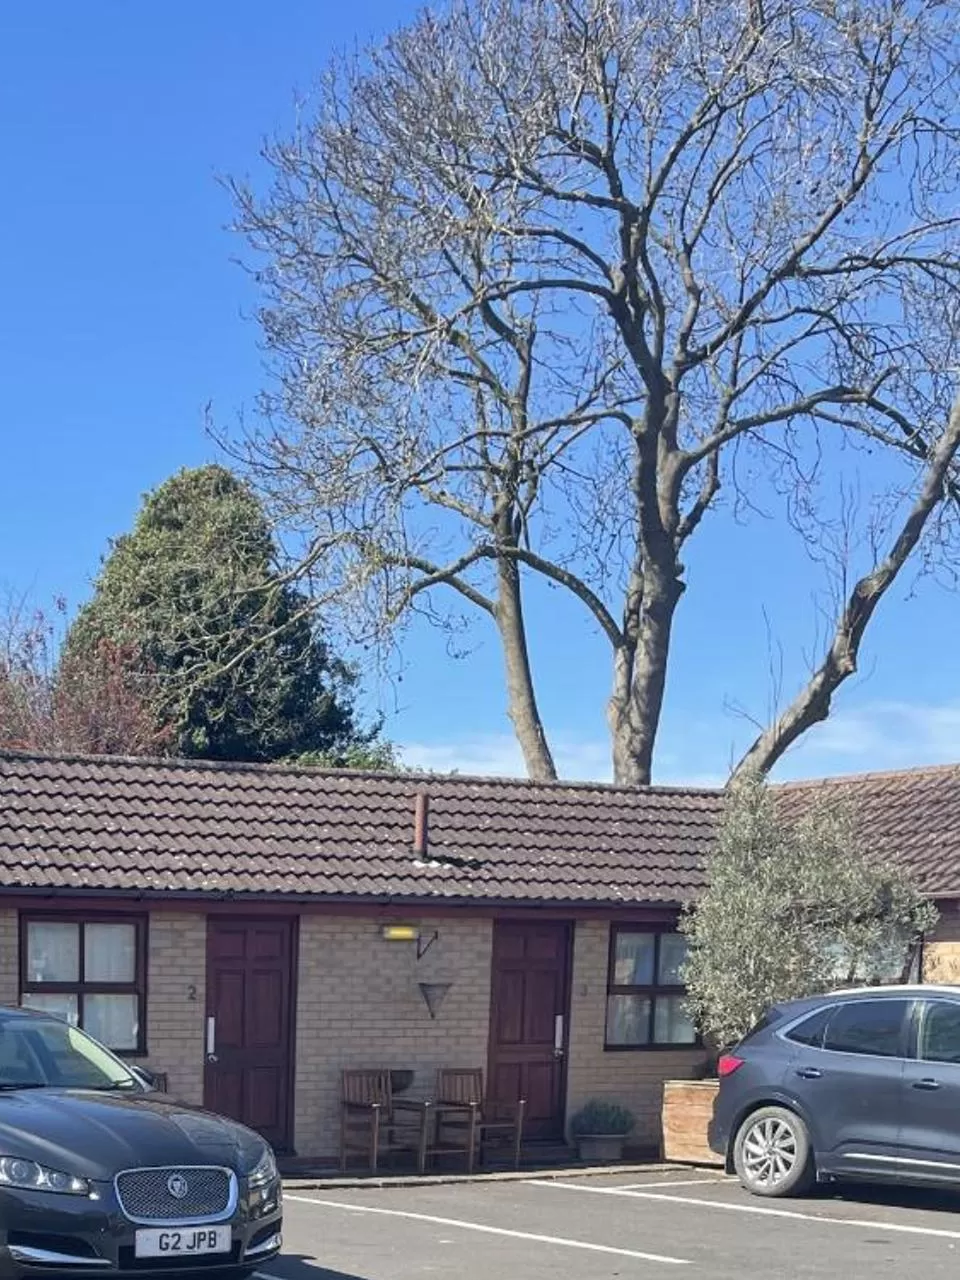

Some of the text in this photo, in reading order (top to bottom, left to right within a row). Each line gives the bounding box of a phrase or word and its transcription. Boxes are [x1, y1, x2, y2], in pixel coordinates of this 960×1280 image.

[187, 984, 196, 1000] 2
[159, 1231, 216, 1251] G2 JPB
